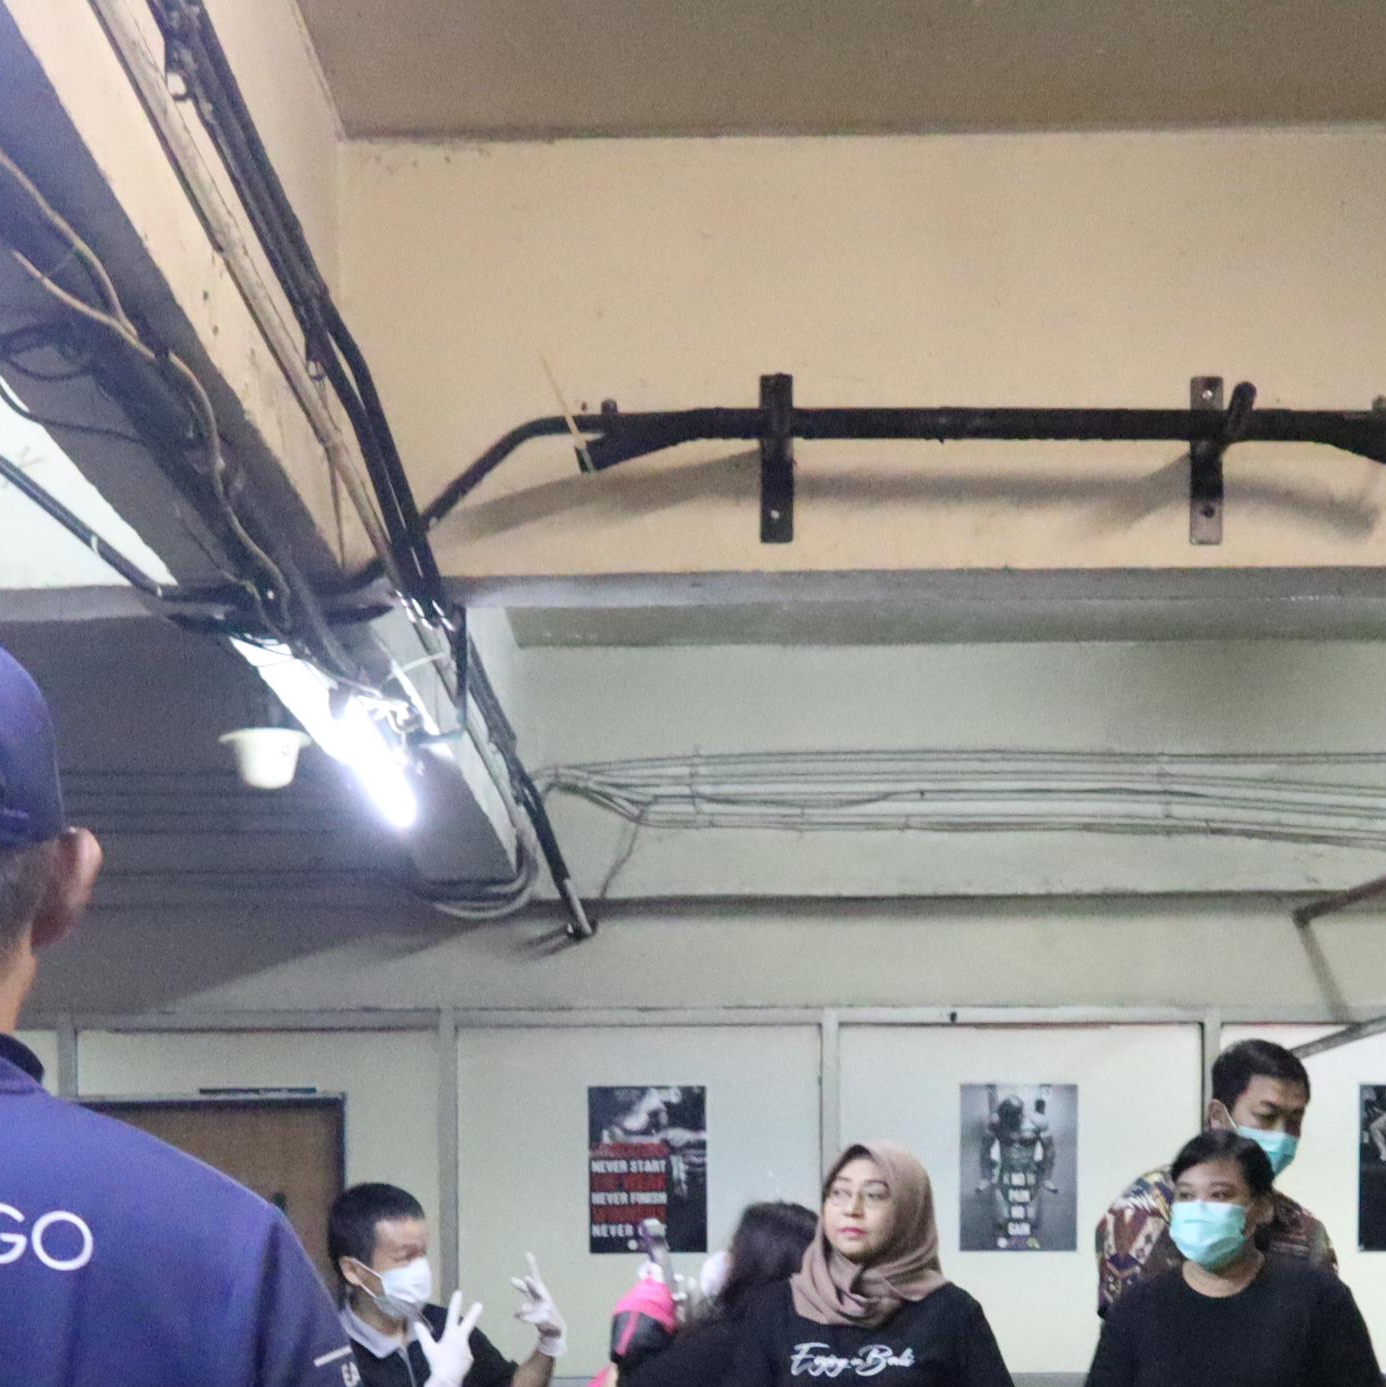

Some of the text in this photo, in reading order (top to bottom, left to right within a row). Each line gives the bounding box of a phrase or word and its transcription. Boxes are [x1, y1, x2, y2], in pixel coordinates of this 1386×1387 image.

[591, 1159, 628, 1173] NEVER
[591, 1191, 629, 1205] NEVER
[591, 1223, 634, 1237] NEVER
